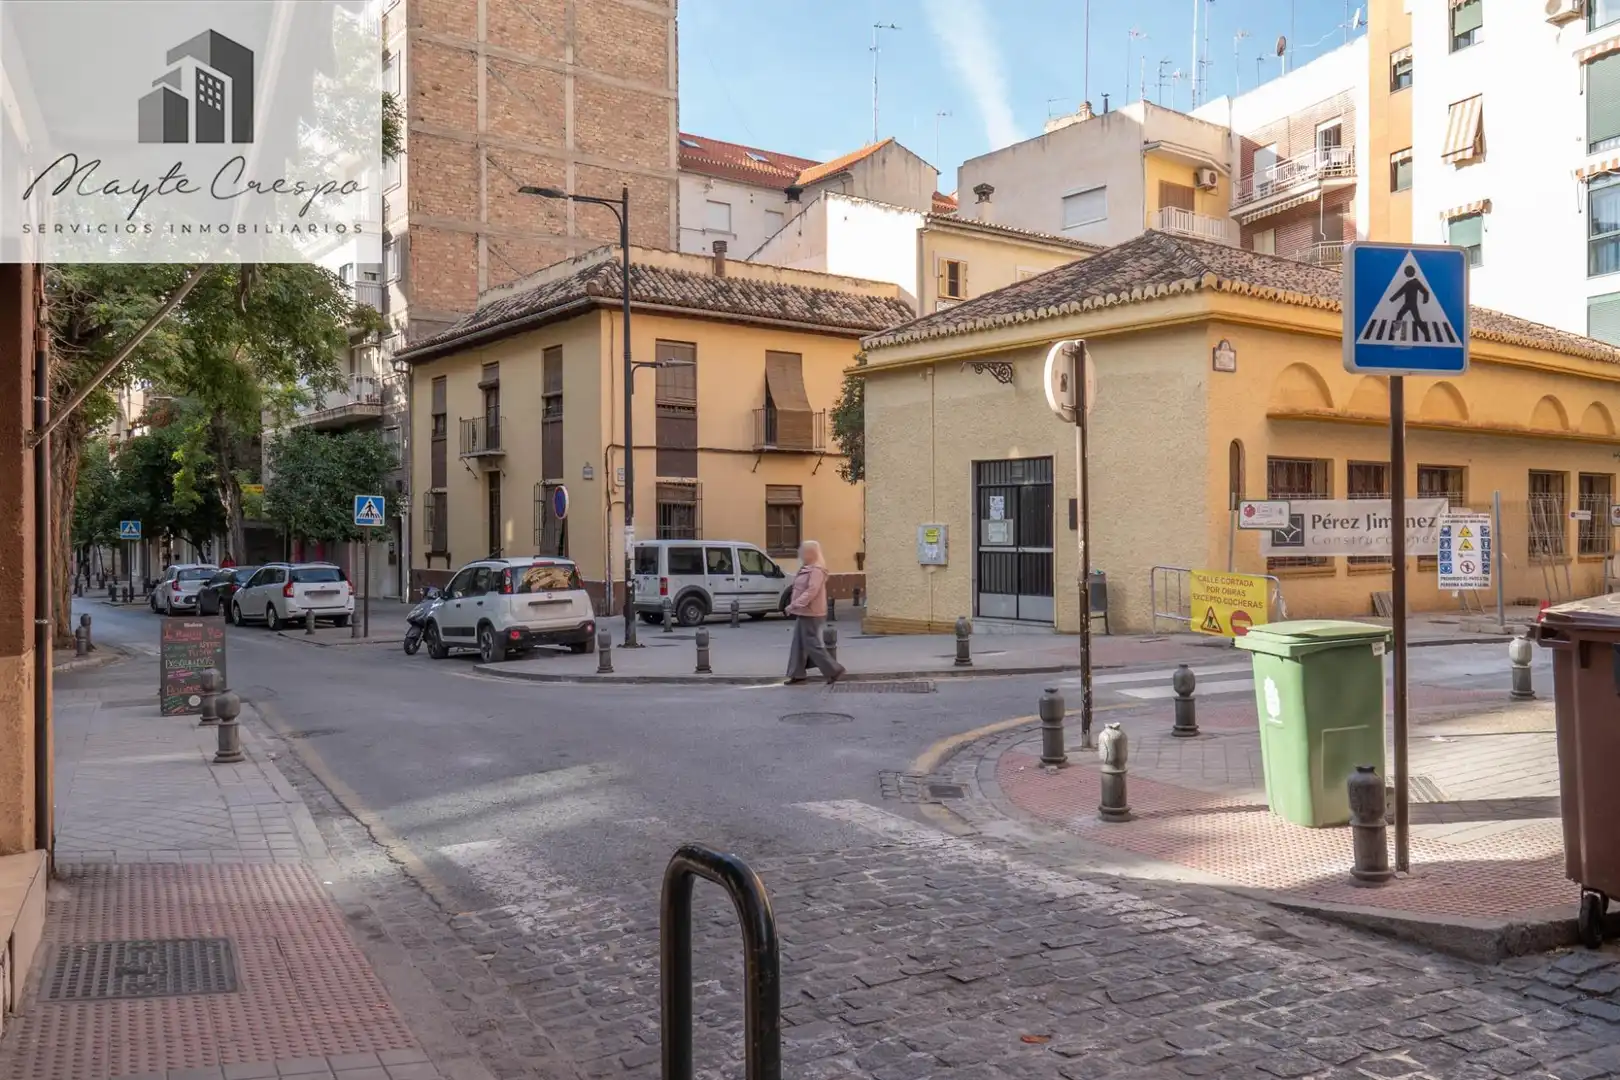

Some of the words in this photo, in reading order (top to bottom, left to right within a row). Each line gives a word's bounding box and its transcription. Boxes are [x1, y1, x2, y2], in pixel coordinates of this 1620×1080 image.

[1311, 513, 1360, 530] Pérez
[1366, 512, 1437, 531] Jimnez
[1197, 575, 1219, 584] CALLE
[1220, 577, 1254, 588] CORTADA
[1221, 587, 1246, 597] OBRAS
[1193, 593, 1222, 604] EXCEPTO
[1222, 598, 1264, 609] COCHERAS
